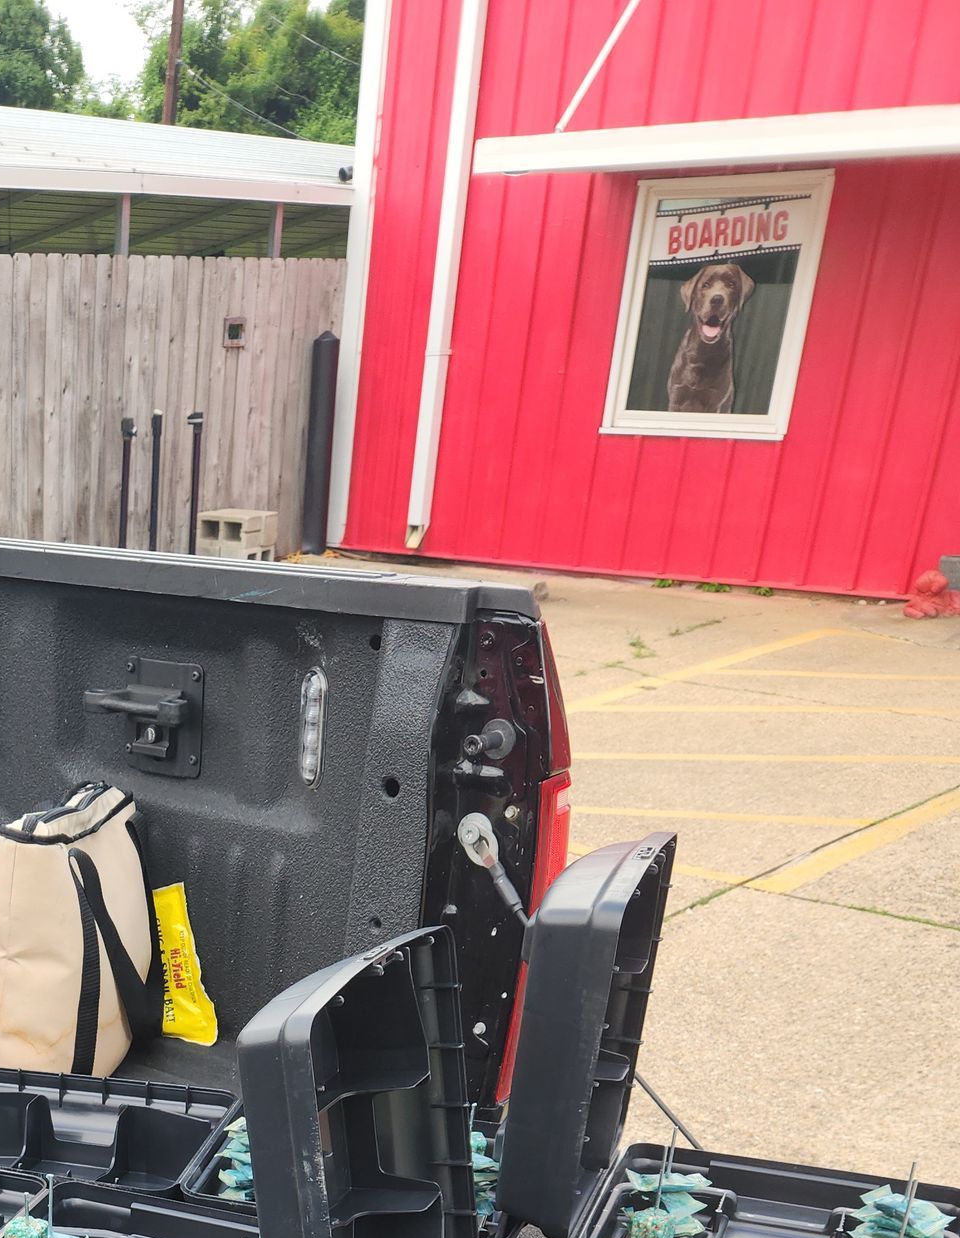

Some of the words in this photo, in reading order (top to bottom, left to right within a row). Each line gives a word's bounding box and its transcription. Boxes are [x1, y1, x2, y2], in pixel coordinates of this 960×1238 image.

[668, 210, 789, 255] BOARDING
[170, 947, 187, 989] Hi-Yield
[164, 998, 175, 1023] BAIT
